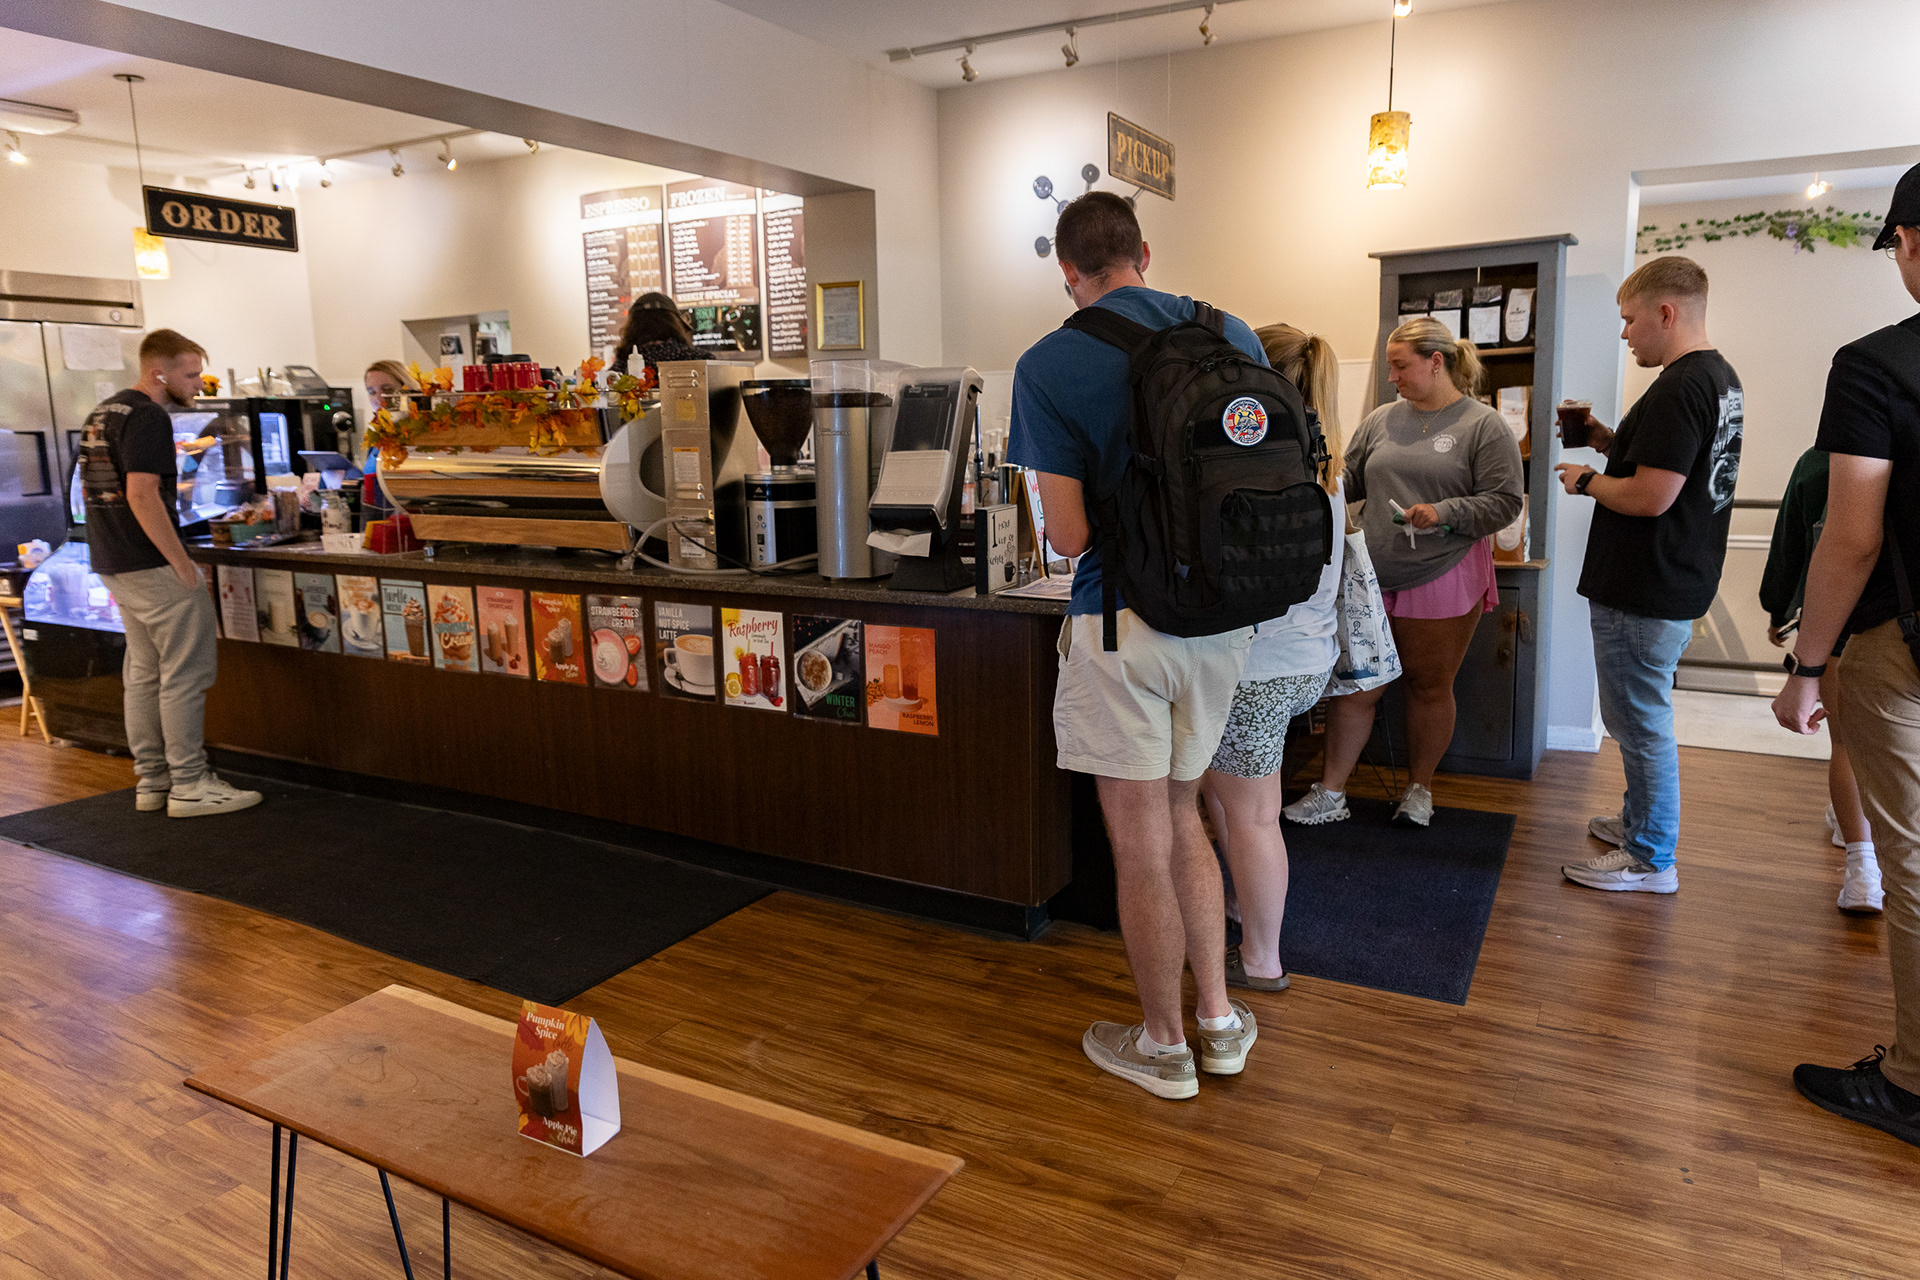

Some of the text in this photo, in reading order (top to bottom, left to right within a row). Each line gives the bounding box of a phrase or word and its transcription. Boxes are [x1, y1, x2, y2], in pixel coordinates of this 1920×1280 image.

[1116, 131, 1170, 182] PICKUP
[669, 186, 726, 208] FROZEN
[584, 196, 650, 218] ESPRESSO
[161, 200, 286, 241] ORDER
[704, 289, 740, 300] SPECIAL
[382, 587, 407, 604] Turtle
[590, 605, 639, 618] STRAWBERRIES
[658, 606, 683, 618] VANILLA
[611, 618, 635, 628] CREAM
[658, 617, 690, 630] NUT SPICE
[728, 617, 778, 639] Raspberry
[441, 632, 474, 649] Cream
[659, 629, 677, 640] LATTE
[825, 693, 855, 708] WINTER
[837, 706, 856, 718] Chai
[902, 712, 934, 720] RASPBERRY
[913, 719, 934, 727] LEMON
[526, 1011, 565, 1031] Pumpkin
[534, 1026, 558, 1040] Spice
[542, 1116, 578, 1136] Apple Pie
